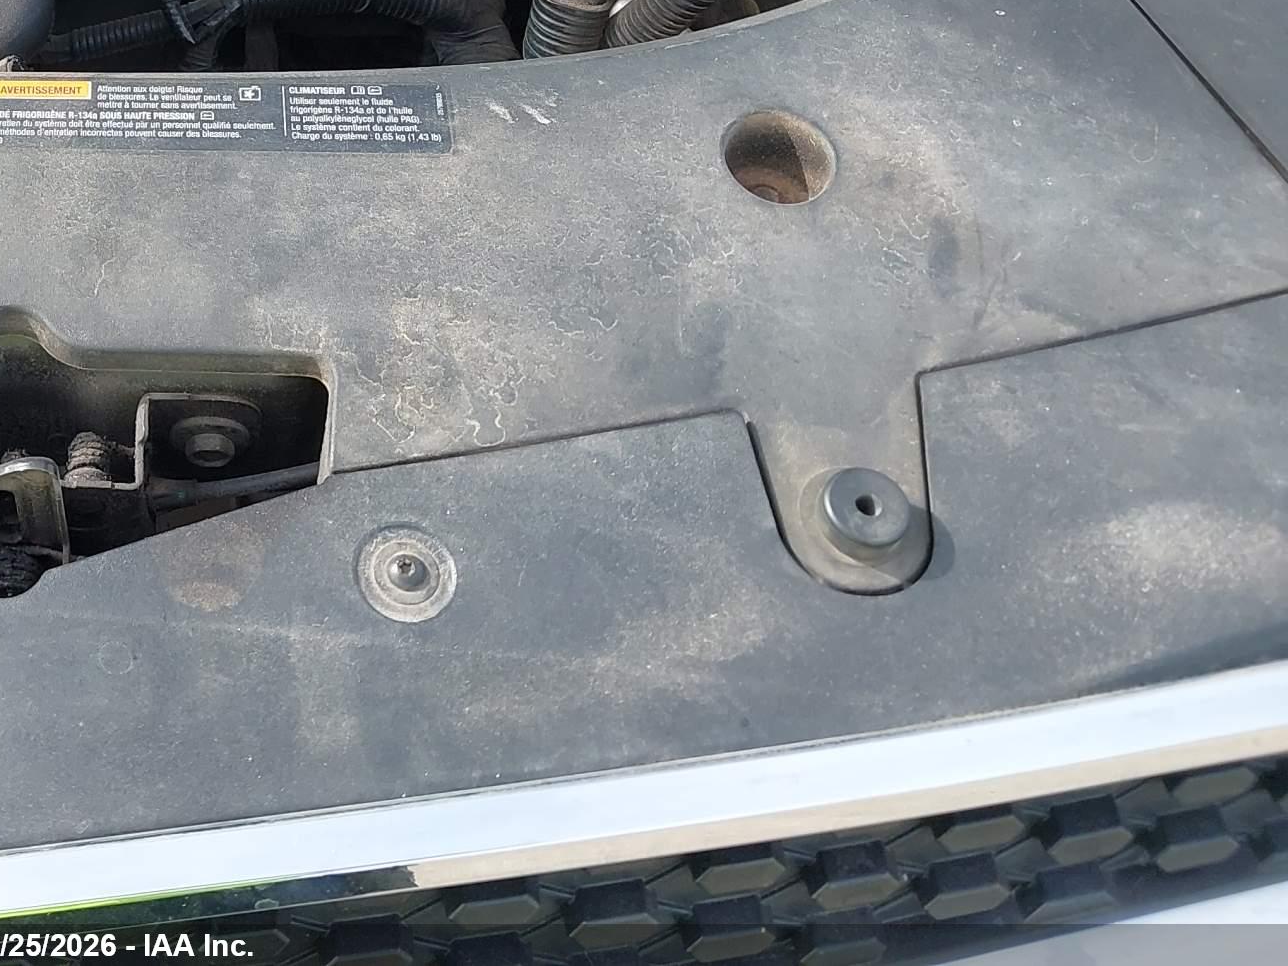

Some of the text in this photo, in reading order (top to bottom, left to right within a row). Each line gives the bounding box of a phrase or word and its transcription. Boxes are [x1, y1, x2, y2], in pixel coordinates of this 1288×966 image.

[0, 86, 82, 94] AVERTISSEMENT
[177, 86, 203, 94] Risque
[204, 95, 220, 103] peut
[290, 97, 317, 105] Utiliser
[371, 98, 393, 106] fluide
[290, 106, 332, 114] frigorigène
[153, 112, 194, 120] PRESSION
[35, 120, 67, 128] système
[69, 120, 83, 128] doit
[162, 122, 201, 130] personnel
[202, 122, 231, 130] qualifié
[303, 124, 336, 132] système
[80, 128, 122, 136] incorrectes
[292, 132, 320, 141] Charge
[334, 133, 368, 141] système
[395, 133, 406, 141] kg
